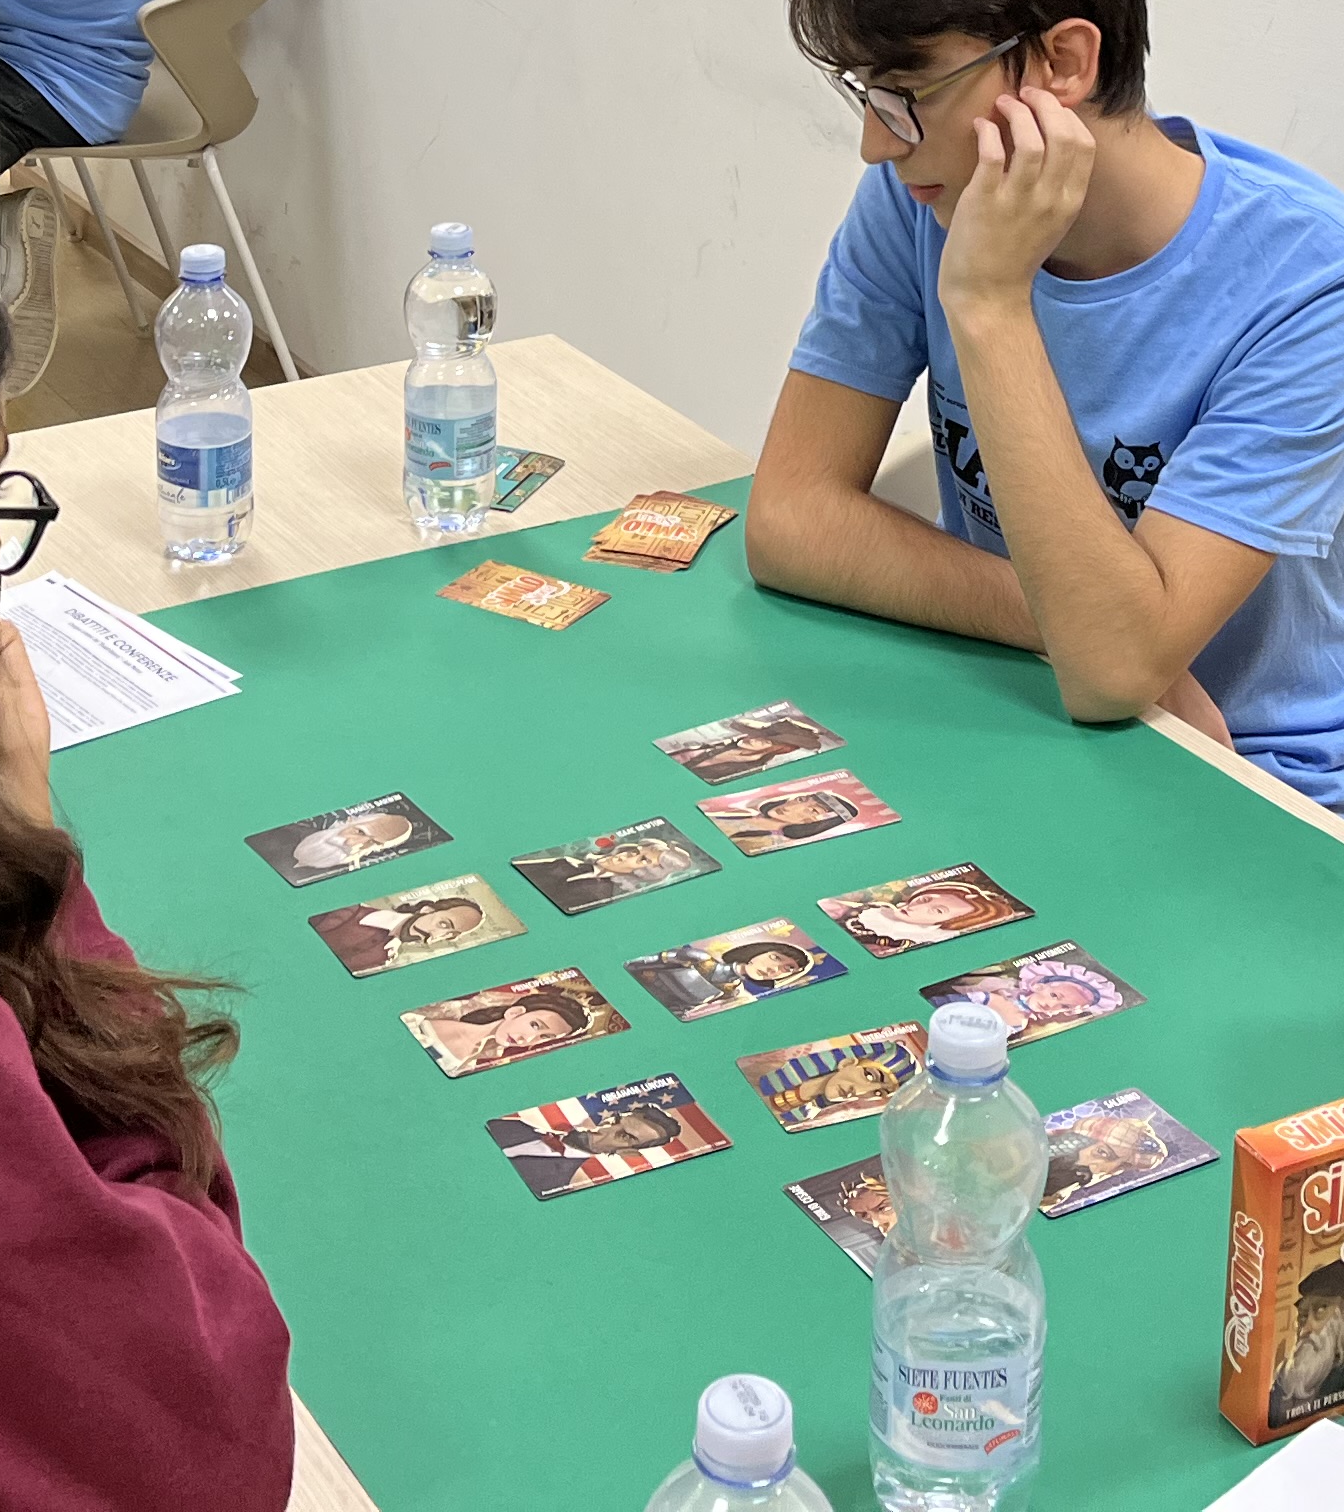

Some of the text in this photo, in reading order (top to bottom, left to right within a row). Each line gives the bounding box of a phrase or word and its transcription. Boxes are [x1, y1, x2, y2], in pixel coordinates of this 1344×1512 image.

[601, 1076, 676, 1103] ABRAHAM LINCOLN
[898, 1364, 1009, 1391] SIETE FUENTES
[911, 1410, 995, 1432] Leonardo
[943, 1402, 977, 1420] San
